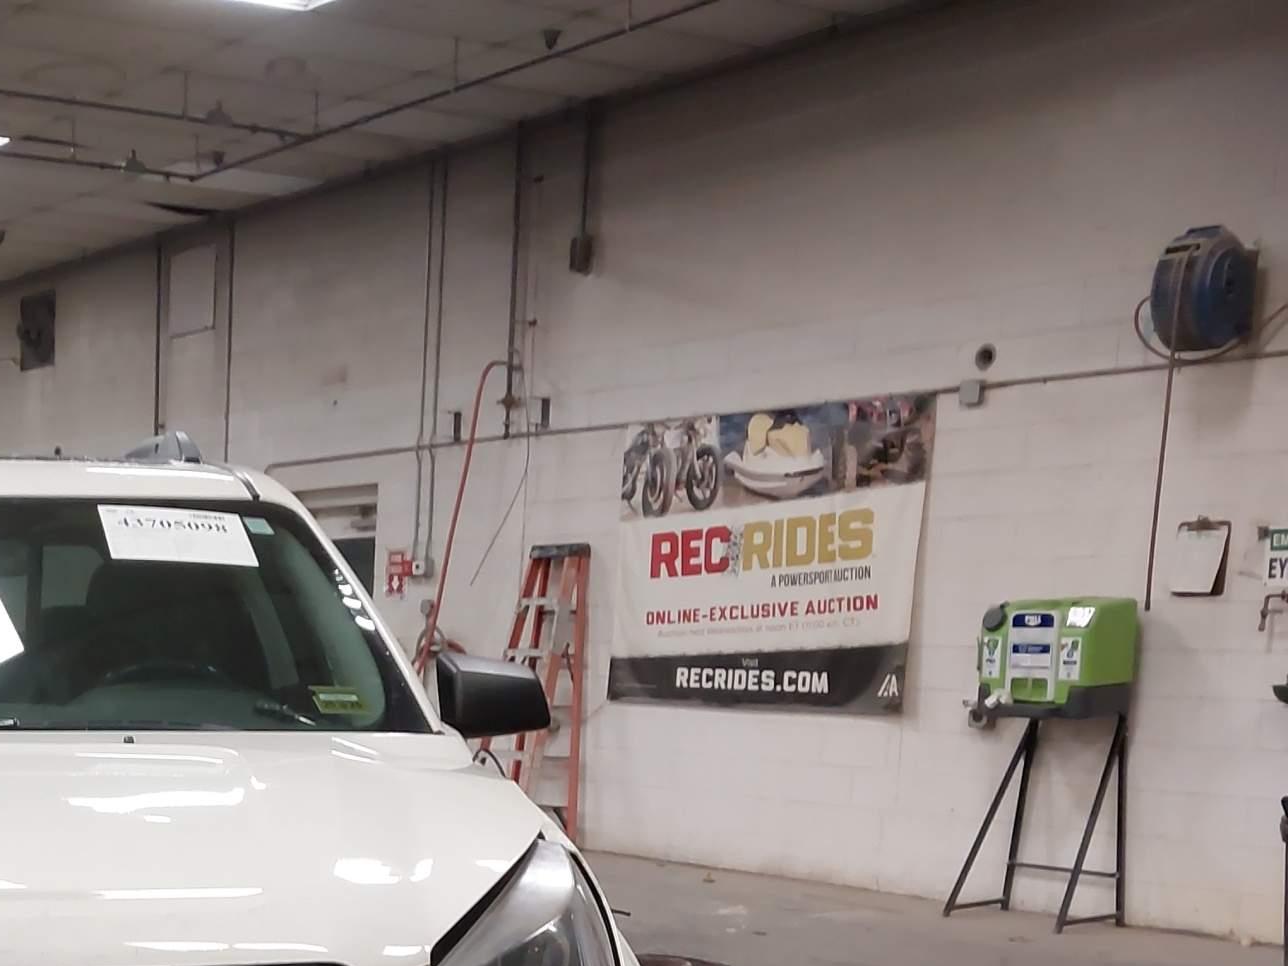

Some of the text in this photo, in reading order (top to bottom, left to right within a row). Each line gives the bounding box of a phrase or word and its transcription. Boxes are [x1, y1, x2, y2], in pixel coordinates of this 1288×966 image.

[649, 507, 875, 579] REC RIDES
[833, 565, 871, 582] AUCTION
[646, 601, 799, 625] ONLINE-EXCLUSIVE
[805, 595, 879, 615] AUCTION
[675, 666, 830, 694] RECRIDES.COM
